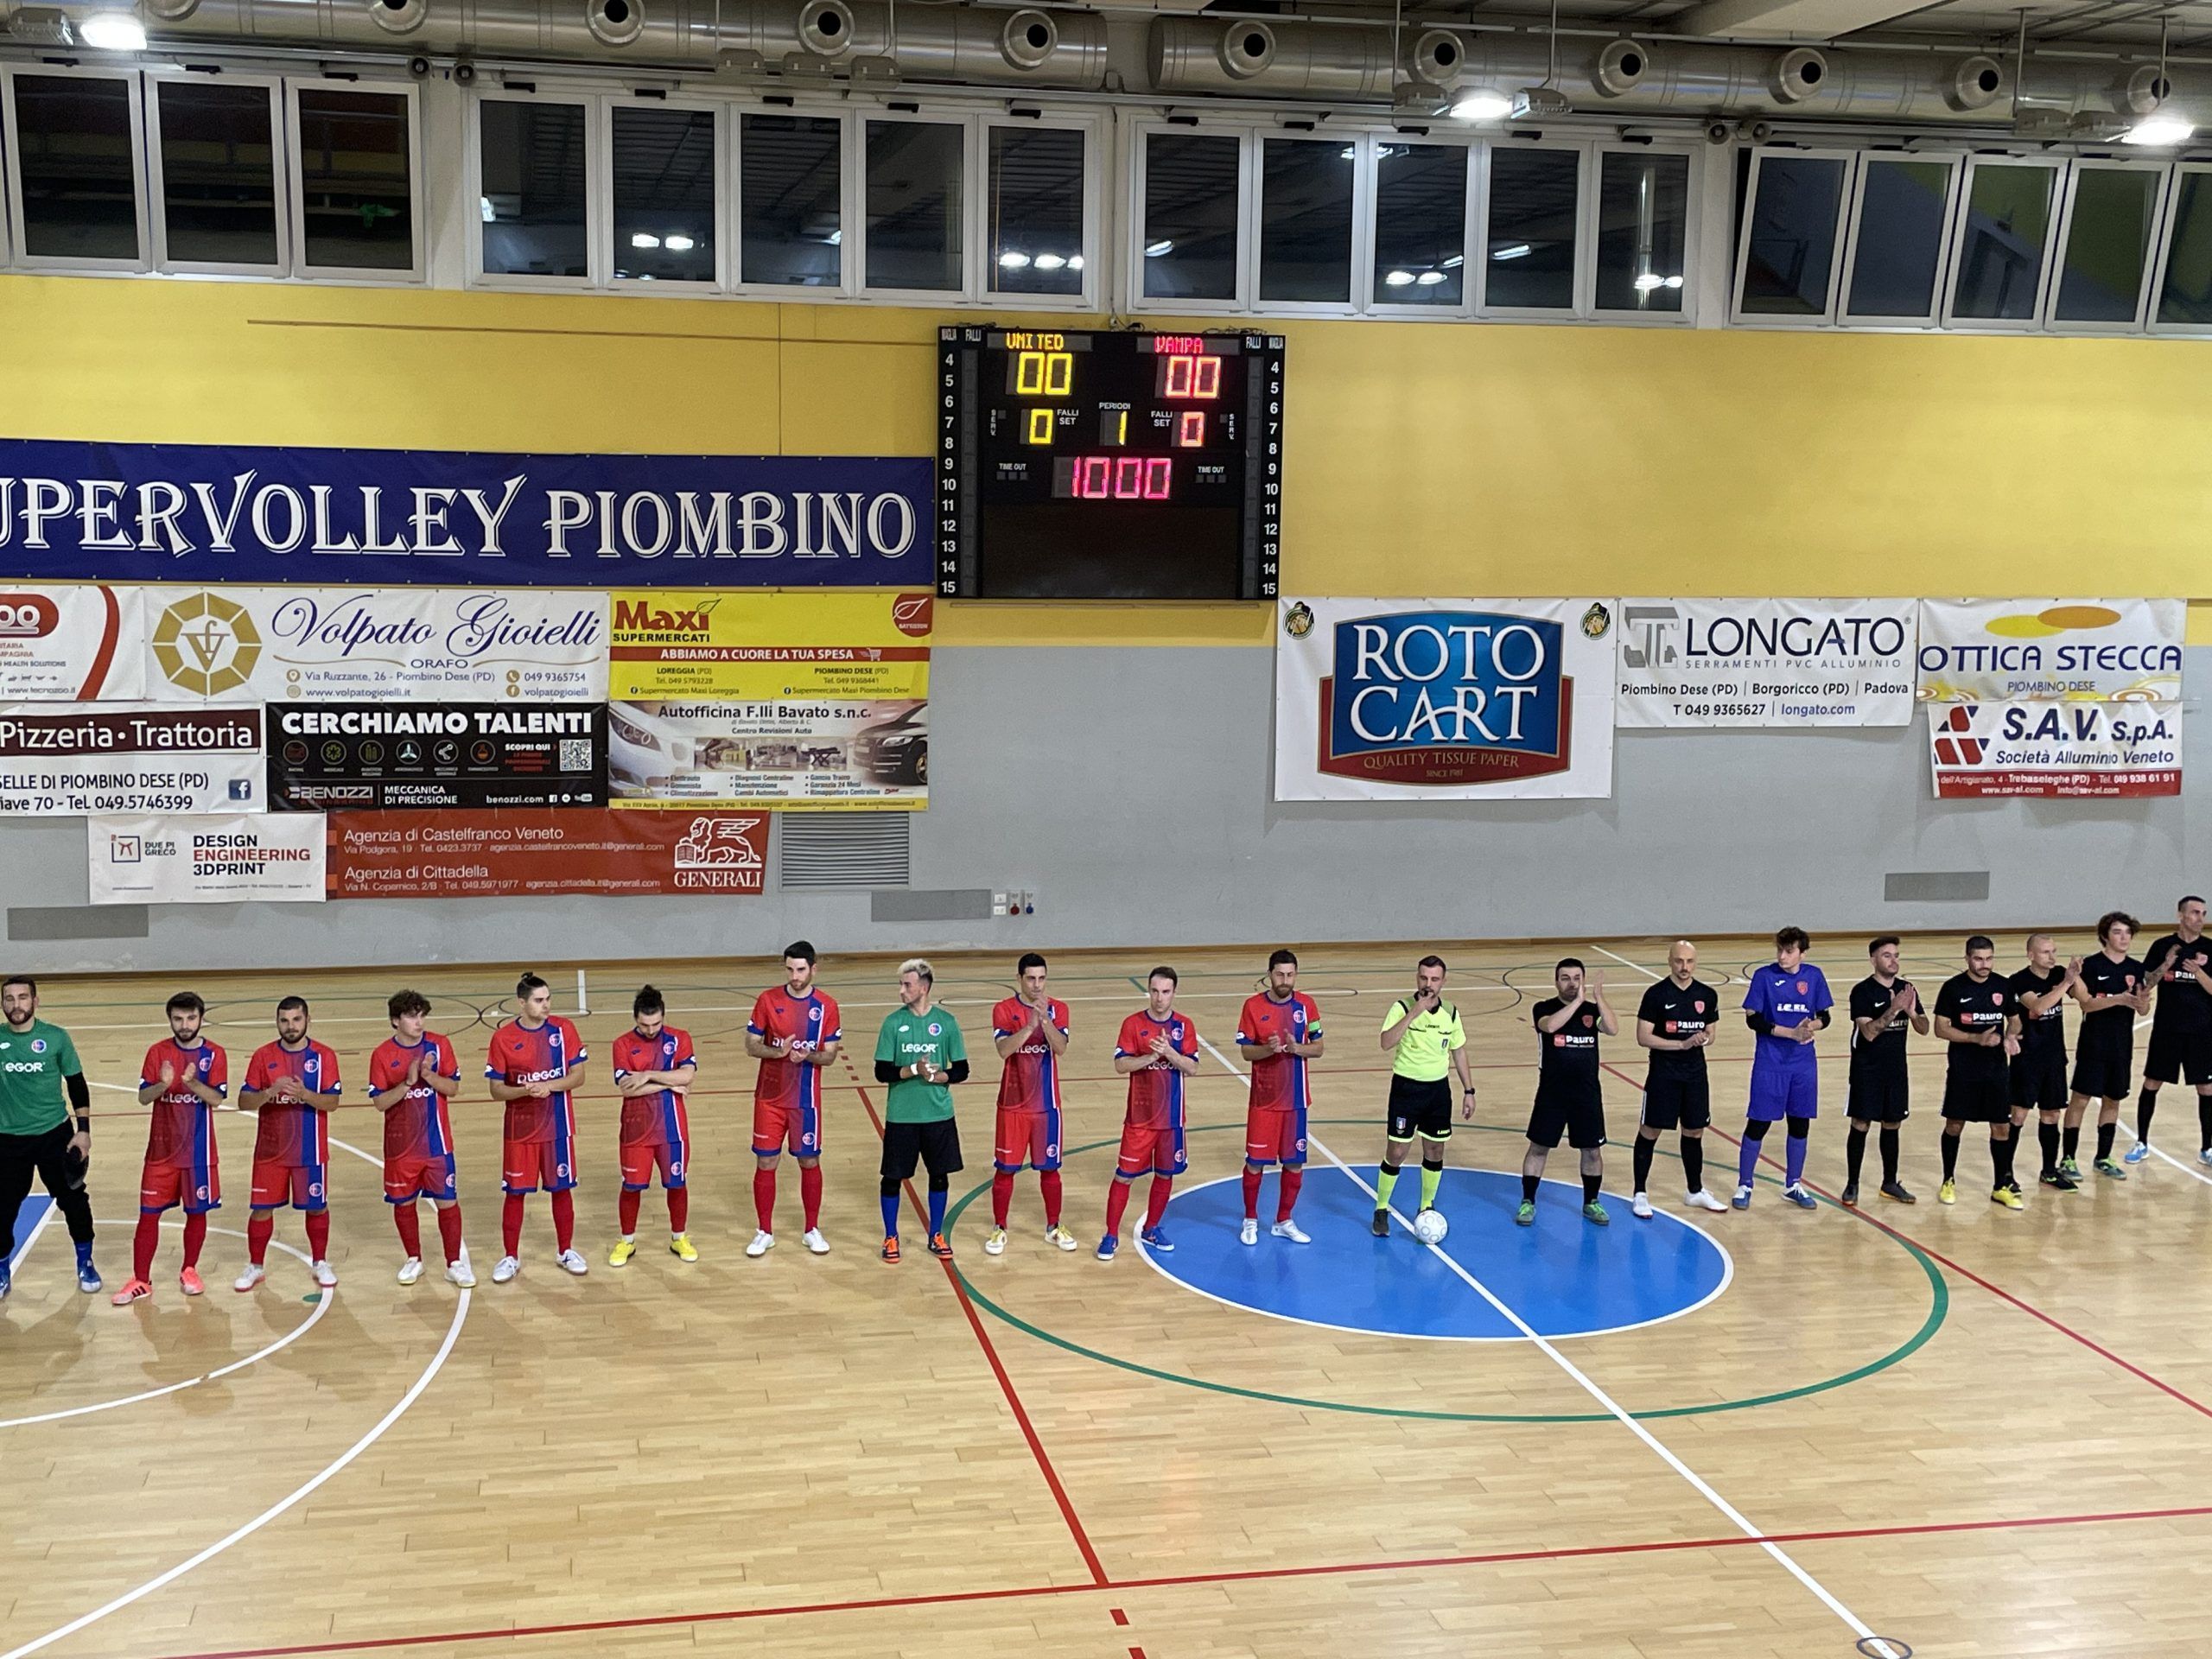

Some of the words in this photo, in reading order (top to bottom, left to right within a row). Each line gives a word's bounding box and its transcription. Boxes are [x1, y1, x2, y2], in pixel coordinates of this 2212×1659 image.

[1006, 333, 1065, 350] UNITED
[1154, 336, 1204, 353] VAMPA
[945, 353, 954, 366] 4
[1271, 361, 1279, 373] 4
[1017, 352, 1073, 395] 00
[1166, 356, 1221, 398] 00
[945, 375, 954, 387] 5
[1270, 382, 1279, 394] 5
[945, 396, 954, 408] 6
[1270, 402, 1278, 414] 6
[945, 416, 954, 429] 7
[1029, 409, 1053, 445] 0
[1119, 410, 1128, 445] 1
[1180, 411, 1205, 447] 0
[1269, 423, 1278, 435] 7
[945, 437, 953, 449] 8
[1268, 442, 1277, 454] 8
[944, 458, 953, 470] 9
[1268, 463, 1276, 475] 9
[942, 479, 956, 491] 10
[1265, 483, 1279, 495] 10
[943, 500, 955, 512] 11
[1265, 503, 1277, 515] 11
[543, 490, 916, 558] PIOMBINO
[942, 520, 956, 532] 12
[1264, 524, 1278, 536] 12
[942, 540, 956, 553] 13
[1264, 543, 1277, 556] 13
[942, 561, 956, 573] 14
[1263, 563, 1277, 575] 14
[942, 582, 956, 594] 15
[1262, 583, 1276, 594] 15
[613, 599, 710, 631] Maxi
[271, 594, 436, 656] Volpato
[446, 594, 601, 657] Gioielli
[613, 633, 710, 643] SUPERMERCATI
[1687, 617, 1904, 657] LONGATO
[661, 650, 718, 659] ABBIAMO
[720, 650, 730, 659] A
[733, 650, 772, 660] CUORE
[774, 650, 790, 659] LA
[791, 650, 815, 660] TUA
[817, 650, 854, 660] SPESA
[1352, 625, 1545, 682] ROTO
[1920, 645, 2042, 672] OTTICA
[2056, 645, 2182, 671] STECCA
[410, 659, 468, 669] ORAFO
[1686, 659, 1777, 669] SERRAMENTI
[1786, 659, 1813, 669] PVC
[1821, 658, 1901, 668] ALLUMINIO
[305, 671, 320, 681] Via
[373, 672, 386, 681] 26
[397, 671, 442, 681] Piombino
[445, 672, 469, 681] Dese
[472, 671, 495, 683] (PD)
[524, 672, 542, 682] 049
[544, 672, 586, 682] 9365754
[1621, 683, 1676, 696] Piombino
[1681, 684, 1709, 696] Dese
[1712, 683, 1738, 696] (PD)
[1752, 683, 1819, 696] Borgoricco
[1823, 683, 1850, 696] (PD)
[1865, 683, 1909, 695] Padova
[2008, 682, 2066, 691] PIOMBINO
[2069, 682, 2095, 691] DESE
[306, 688, 411, 698] www.volpatogioielli.it
[524, 688, 588, 698] volpatogioielli
[658, 705, 741, 719] Autofficina
[779, 706, 830, 719] Bavato
[834, 709, 871, 719] s.n.c.
[1350, 685, 1537, 743] CART
[1673, 705, 1682, 715] T
[1685, 704, 1710, 715] 049
[1713, 704, 1766, 715] 9365627
[1782, 703, 1855, 719] longato.com
[281, 712, 468, 734] CERCHIAMO
[474, 712, 592, 734] TALENTI
[2002, 707, 2099, 741] S.A.V.
[0, 721, 113, 748] Pizzeria
[130, 721, 252, 747] Trattoria
[536, 743, 551, 752] QUI
[1363, 753, 1428, 770] QUALITY
[1433, 752, 1477, 765] TISSUE
[1480, 753, 1519, 768] PAPER
[1996, 750, 2050, 764] Società
[2055, 750, 2118, 765] Alluminio
[2124, 749, 2174, 764] Veneto
[41, 774, 56, 789] DI
[60, 773, 135, 789] PIOMBINO
[140, 773, 175, 788] DESE
[179, 772, 209, 790] (PD)
[2009, 774, 2070, 785] Trebaseleghe
[2072, 774, 2090, 785] (PD)
[2129, 774, 2146, 783] 938
[2149, 773, 2160, 783] 61
[2164, 773, 2175, 783] 91
[385, 785, 446, 795] MECCANICA
[34, 797, 54, 811] 70
[94, 795, 193, 810] 049.5746399
[385, 796, 396, 804] DI
[398, 795, 458, 804] PRECISIONE
[486, 795, 543, 804] benozzi.com
[194, 835, 257, 848] DESIGN
[344, 830, 401, 845] Agenzia
[405, 829, 418, 841] di
[423, 827, 511, 841] Castelfranco
[515, 827, 564, 840] Veneto
[194, 849, 311, 861] ENGINEERING
[194, 863, 266, 876] 3DPRINT
[345, 867, 402, 882] Agenzia
[406, 866, 419, 878] di
[423, 865, 488, 879] Cittadella
[674, 872, 761, 887] GENERALI
[1973, 1013, 2003, 1021] Pauro
[1567, 1035, 1595, 1044] Pauro
